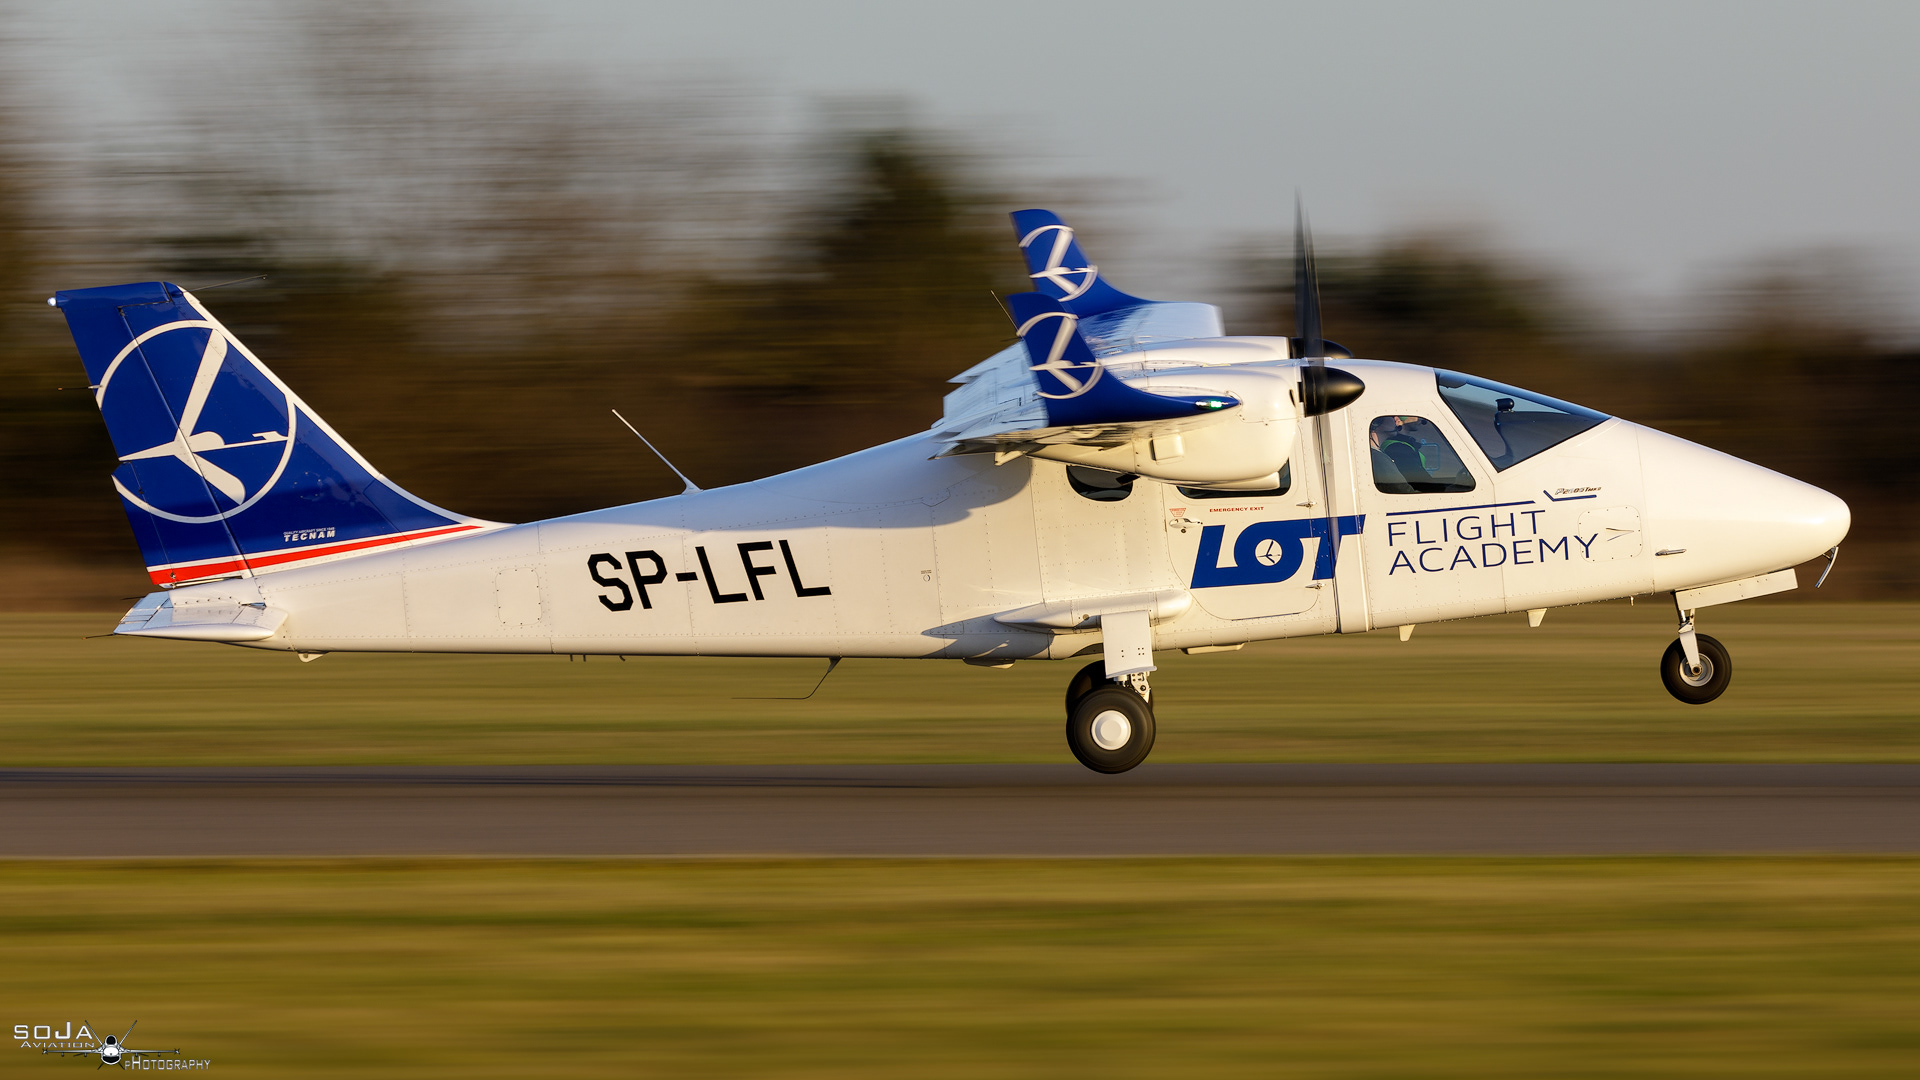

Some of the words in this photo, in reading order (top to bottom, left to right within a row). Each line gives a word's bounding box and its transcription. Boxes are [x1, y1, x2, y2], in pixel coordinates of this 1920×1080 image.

[284, 530, 335, 542] TECNAM
[1387, 509, 1546, 547] FLIGHT
[1190, 514, 1366, 589] LOT
[1388, 532, 1599, 576] ACADEMY
[587, 539, 832, 612] SP-LFL
